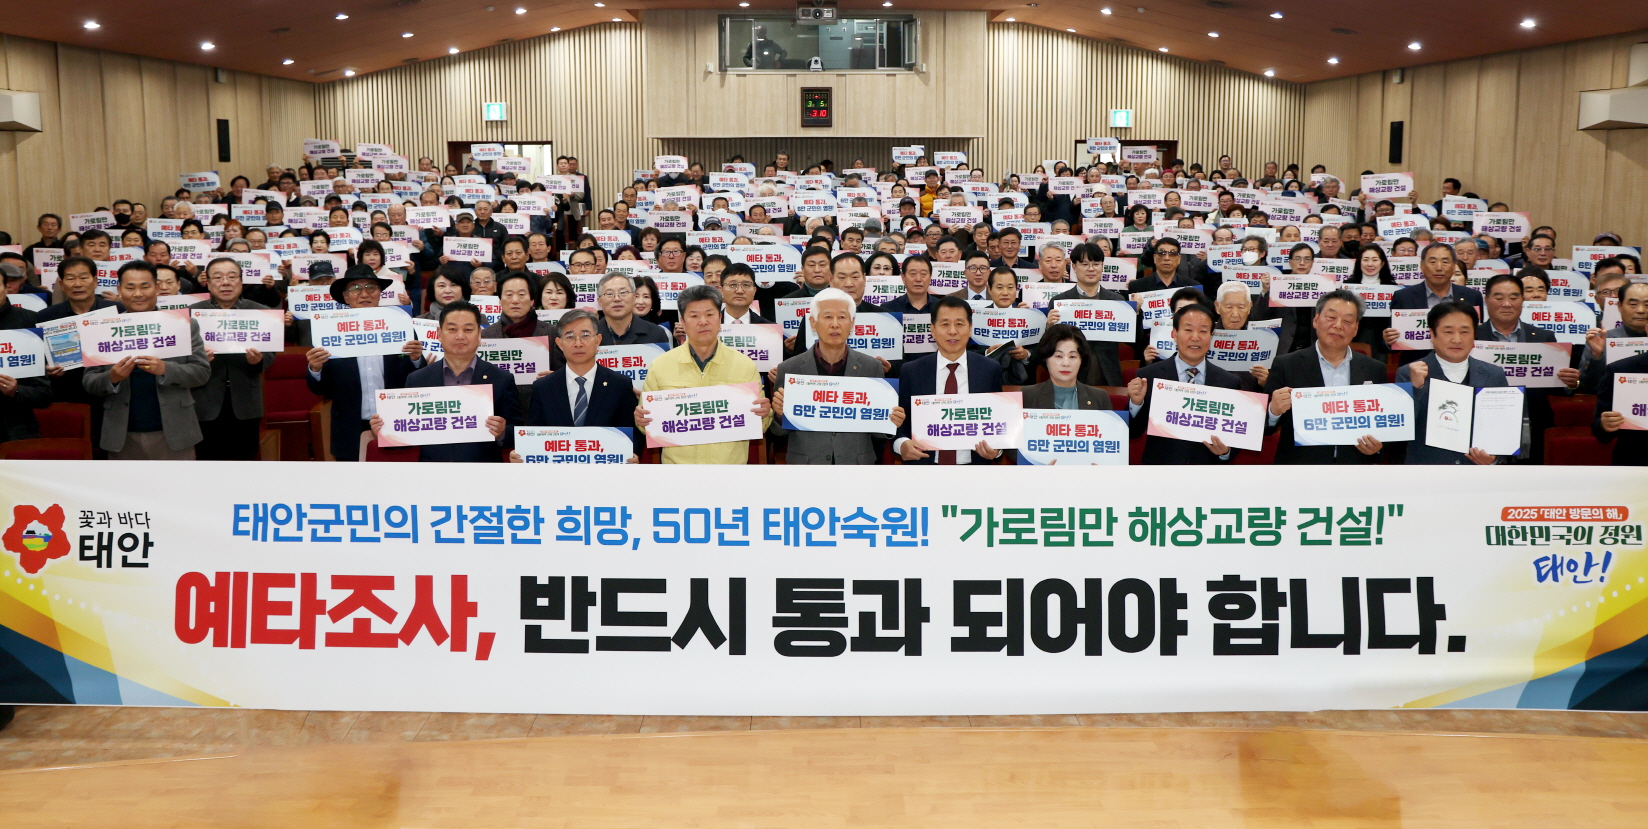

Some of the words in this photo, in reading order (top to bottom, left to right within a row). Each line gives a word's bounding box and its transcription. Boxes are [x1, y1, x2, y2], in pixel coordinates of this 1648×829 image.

[746, 254, 763, 262] 예타
[765, 254, 784, 264] 통과,
[1212, 258, 1224, 266] 6만
[778, 264, 796, 272] 염원!
[1321, 265, 1349, 274] 가로림만
[1392, 264, 1419, 272] 가로림만
[1578, 261, 1592, 270] 6만
[246, 268, 261, 276] 건설
[1112, 274, 1128, 282] 건설
[1288, 282, 1318, 290] 가로림만
[1550, 278, 1570, 288] 통과,
[305, 294, 322, 302] 예타
[1278, 292, 1310, 300] 해상교량
[1563, 288, 1582, 298] 염원!
[294, 304, 308, 312] 6만
[310, 302, 334, 311] 군민의
[1148, 300, 1165, 309] 예타
[1074, 310, 1092, 319] 예타
[1094, 310, 1116, 321] 통과,
[1532, 312, 1551, 322] 예타
[1553, 312, 1576, 323] 통과,
[217, 320, 260, 331] 가로림만
[337, 320, 361, 334] 예타
[363, 318, 390, 332] 통과,
[783, 320, 800, 330] 6만
[987, 318, 1006, 328] 예타
[1008, 318, 1028, 329] 통과,
[1078, 321, 1106, 331] 군민의
[1108, 322, 1129, 332] 염원!
[110, 323, 162, 338] 가로림만
[204, 331, 248, 343] 해상교량
[252, 330, 271, 342] 건설
[854, 325, 879, 337] 통과,
[974, 328, 990, 336] 6만
[992, 328, 1018, 338] 군민의
[1020, 328, 1040, 338] 염원!
[98, 338, 150, 353] 해상교량
[152, 334, 177, 350] 건설
[321, 334, 342, 347] 6만
[344, 332, 379, 346] 군민의
[380, 330, 406, 344] 염원!
[870, 338, 895, 350] 염원!
[1156, 340, 1173, 350] 6만
[1214, 340, 1235, 350] 예타
[1238, 340, 1260, 351] 통과,
[7, 354, 36, 368] 염원!
[478, 350, 522, 362] 가로림만
[747, 350, 770, 361] 건설
[1217, 350, 1248, 362] 군민의
[1250, 350, 1271, 362] 염원!
[1493, 353, 1542, 364] 가로림만
[512, 362, 536, 374] 건설
[597, 357, 619, 368] 예타
[620, 356, 648, 369] 통과,
[1530, 366, 1554, 378] 건설
[812, 390, 839, 403] 예타
[842, 391, 871, 406] 통과,
[407, 400, 462, 416] 가로림만
[675, 400, 729, 416] 가로림만
[1182, 397, 1236, 418] 가로림만
[1321, 400, 1350, 414] 예타
[1352, 398, 1384, 414] 통과,
[792, 404, 817, 418] 6만
[819, 405, 858, 420] 군민의
[860, 406, 889, 421] 염원!
[940, 406, 992, 421] 가로림만
[393, 415, 448, 432] 해상교량
[450, 414, 478, 430] 건설
[662, 416, 716, 434] 해상교량
[718, 414, 746, 429] 건설
[1165, 410, 1219, 432] 해상교량
[1220, 418, 1248, 435] 건설
[1304, 417, 1328, 431] 6만
[1330, 415, 1371, 430] 군민의
[1373, 414, 1405, 428] 염원!
[926, 422, 979, 437] 해상교량
[981, 421, 1008, 436] 건설
[1046, 424, 1072, 437] 예타
[1074, 424, 1102, 439] 통과,
[544, 440, 571, 452] 예타
[574, 439, 604, 453] 통과,
[1027, 440, 1050, 453] 6만
[1052, 440, 1090, 454] 군민의
[1092, 440, 1120, 454] 염원!
[78, 510, 112, 530] 꽃과
[118, 510, 150, 530] 바다
[1506, 508, 1538, 520] 2025
[1568, 508, 1604, 520] 방문의
[232, 502, 418, 544] 태안군민의
[430, 504, 545, 546] 간절한
[555, 505, 642, 551] 희망,
[652, 506, 750, 546] 50년
[763, 506, 929, 548] 태안숙원!
[942, 504, 1118, 548] "가로림만
[1128, 506, 1286, 547] 해상교량
[1296, 504, 1404, 546] 건설!"
[1485, 525, 1594, 546] 대한민국의
[1598, 524, 1643, 546] 정원
[79, 532, 154, 568] 태안
[1532, 550, 1612, 584] 태안!
[174, 571, 496, 661] 예타조사,
[520, 576, 747, 656] 반드시
[772, 578, 930, 658] 통과
[950, 577, 1188, 656] 되어야
[1206, 574, 1467, 656] 합니다.
